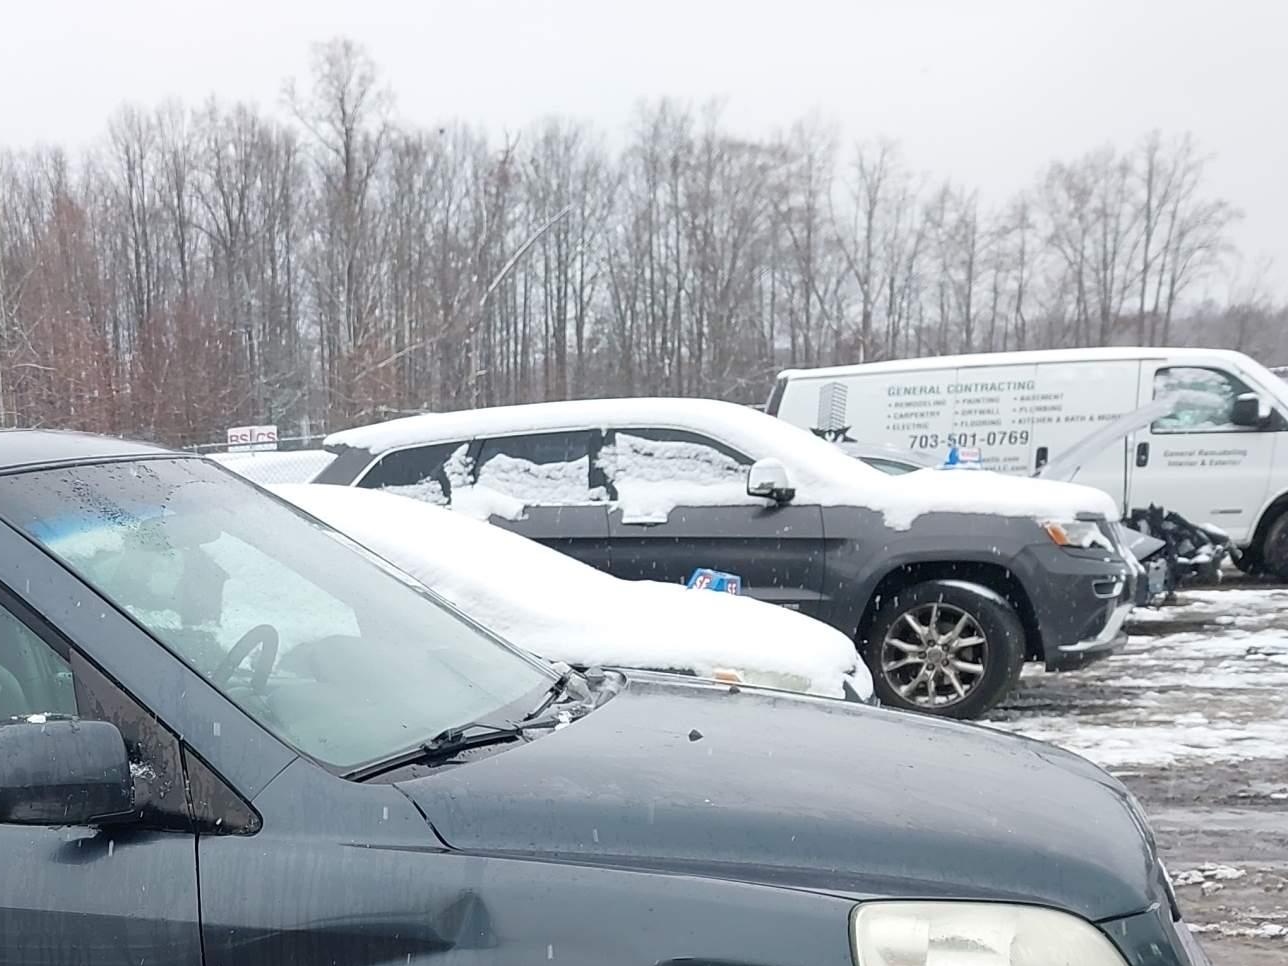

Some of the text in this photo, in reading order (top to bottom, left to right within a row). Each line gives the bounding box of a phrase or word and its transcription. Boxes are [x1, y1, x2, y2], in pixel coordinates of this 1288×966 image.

[887, 380, 1035, 397] GENERAL CONTRACTING
[909, 431, 1029, 449] 703-501-0769
